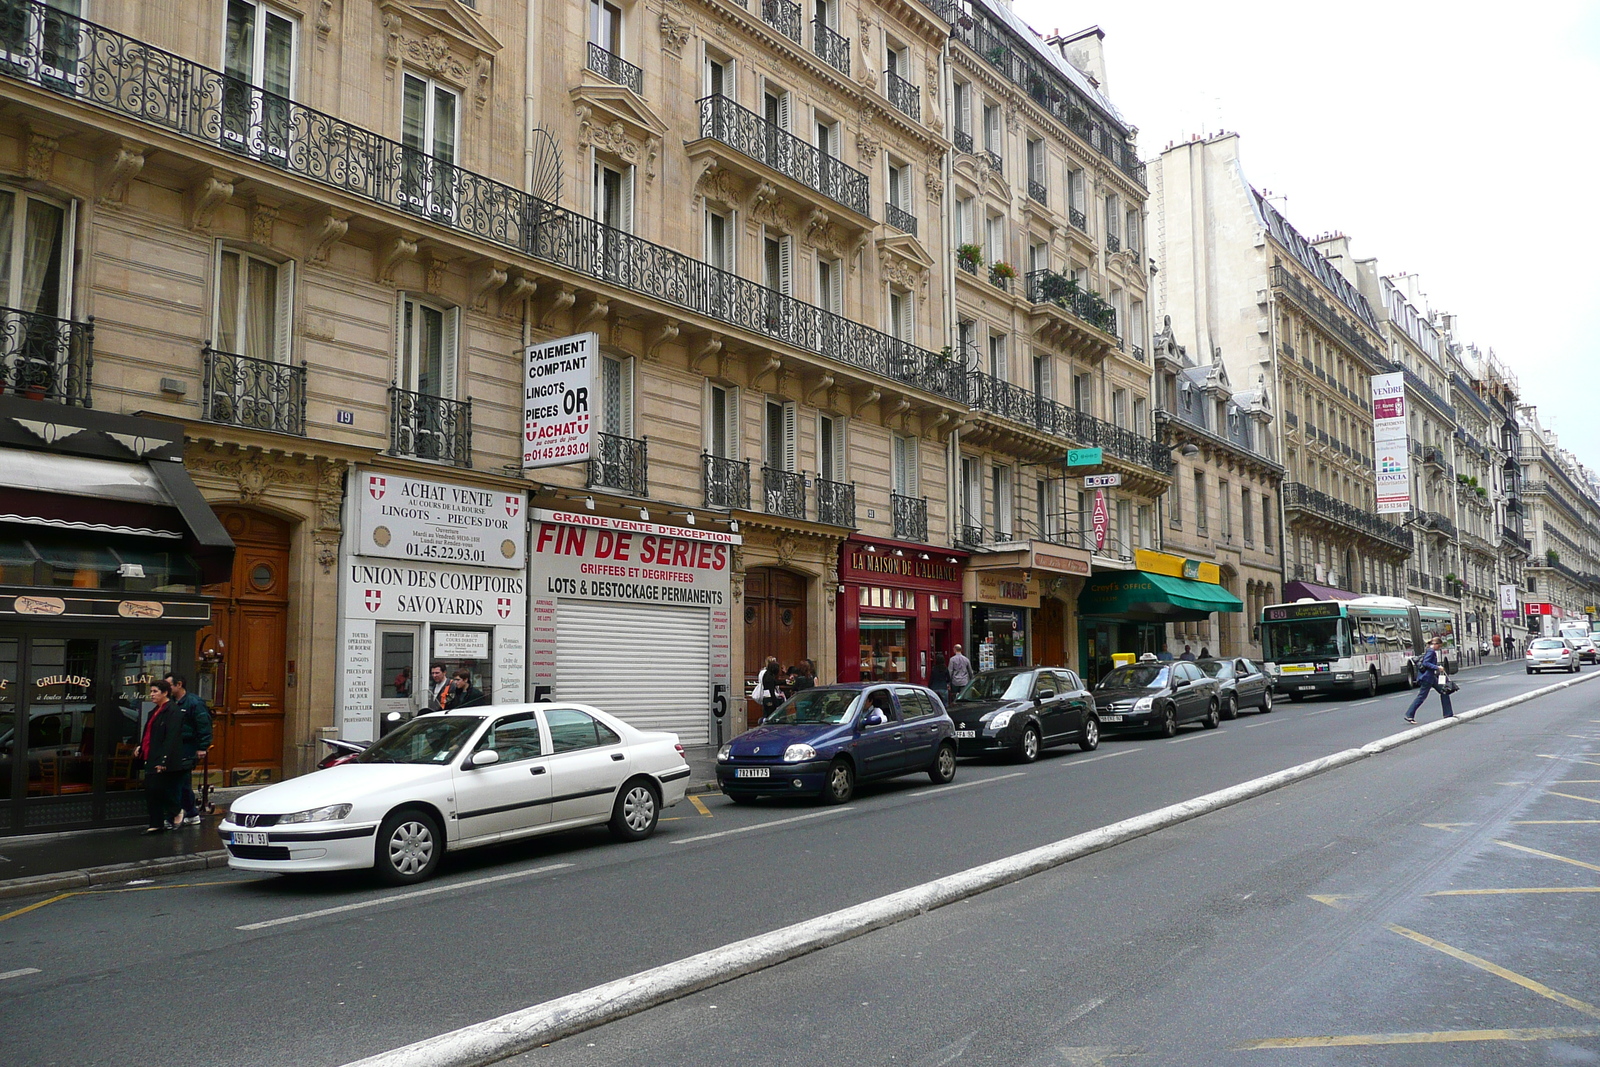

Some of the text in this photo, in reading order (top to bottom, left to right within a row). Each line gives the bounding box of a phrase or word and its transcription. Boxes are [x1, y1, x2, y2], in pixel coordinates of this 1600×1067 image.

[530, 340, 586, 362] PAIEMENT
[529, 356, 587, 378] COMPTANT
[526, 382, 588, 415] LINGOTS OR
[1373, 386, 1403, 395] VENDRE
[340, 411, 351, 423] 19
[526, 405, 558, 420] PIECES
[538, 422, 576, 439] ACHAT
[532, 449, 541, 460] 01
[543, 448, 553, 458] 45
[1086, 476, 1116, 486] LOTO
[401, 482, 493, 507] ACHAT VENTE
[418, 500, 442, 509] COURS
[462, 505, 486, 514] BOURSE
[382, 505, 429, 520] LINGOTS
[448, 514, 483, 527] PIECES
[485, 518, 508, 530] D'OR
[553, 512, 731, 542] GRANDE VENTE D'EXCEPTION
[1094, 498, 1105, 541] TABAC
[435, 532, 456, 540] Vendredi
[443, 539, 473, 548] Rendez-vous
[406, 542, 486, 562] 01.45.22.93.01
[536, 523, 726, 570] FIN DE SERIES
[580, 564, 694, 583] GRIFFEES ET DEGRIFFEES
[852, 553, 957, 582] LA MAISON DE L'ALLIANCE
[351, 565, 523, 594] UNION DES COMPTOIRS
[548, 577, 722, 604] LOTS & DESTOCKAGE PERMANENTS
[398, 595, 482, 616] SAVOYARDS
[1274, 610, 1285, 618] 80
[36, 674, 91, 688] GRILLADES
[713, 684, 727, 718] 5
[258, 834, 265, 844] 93
